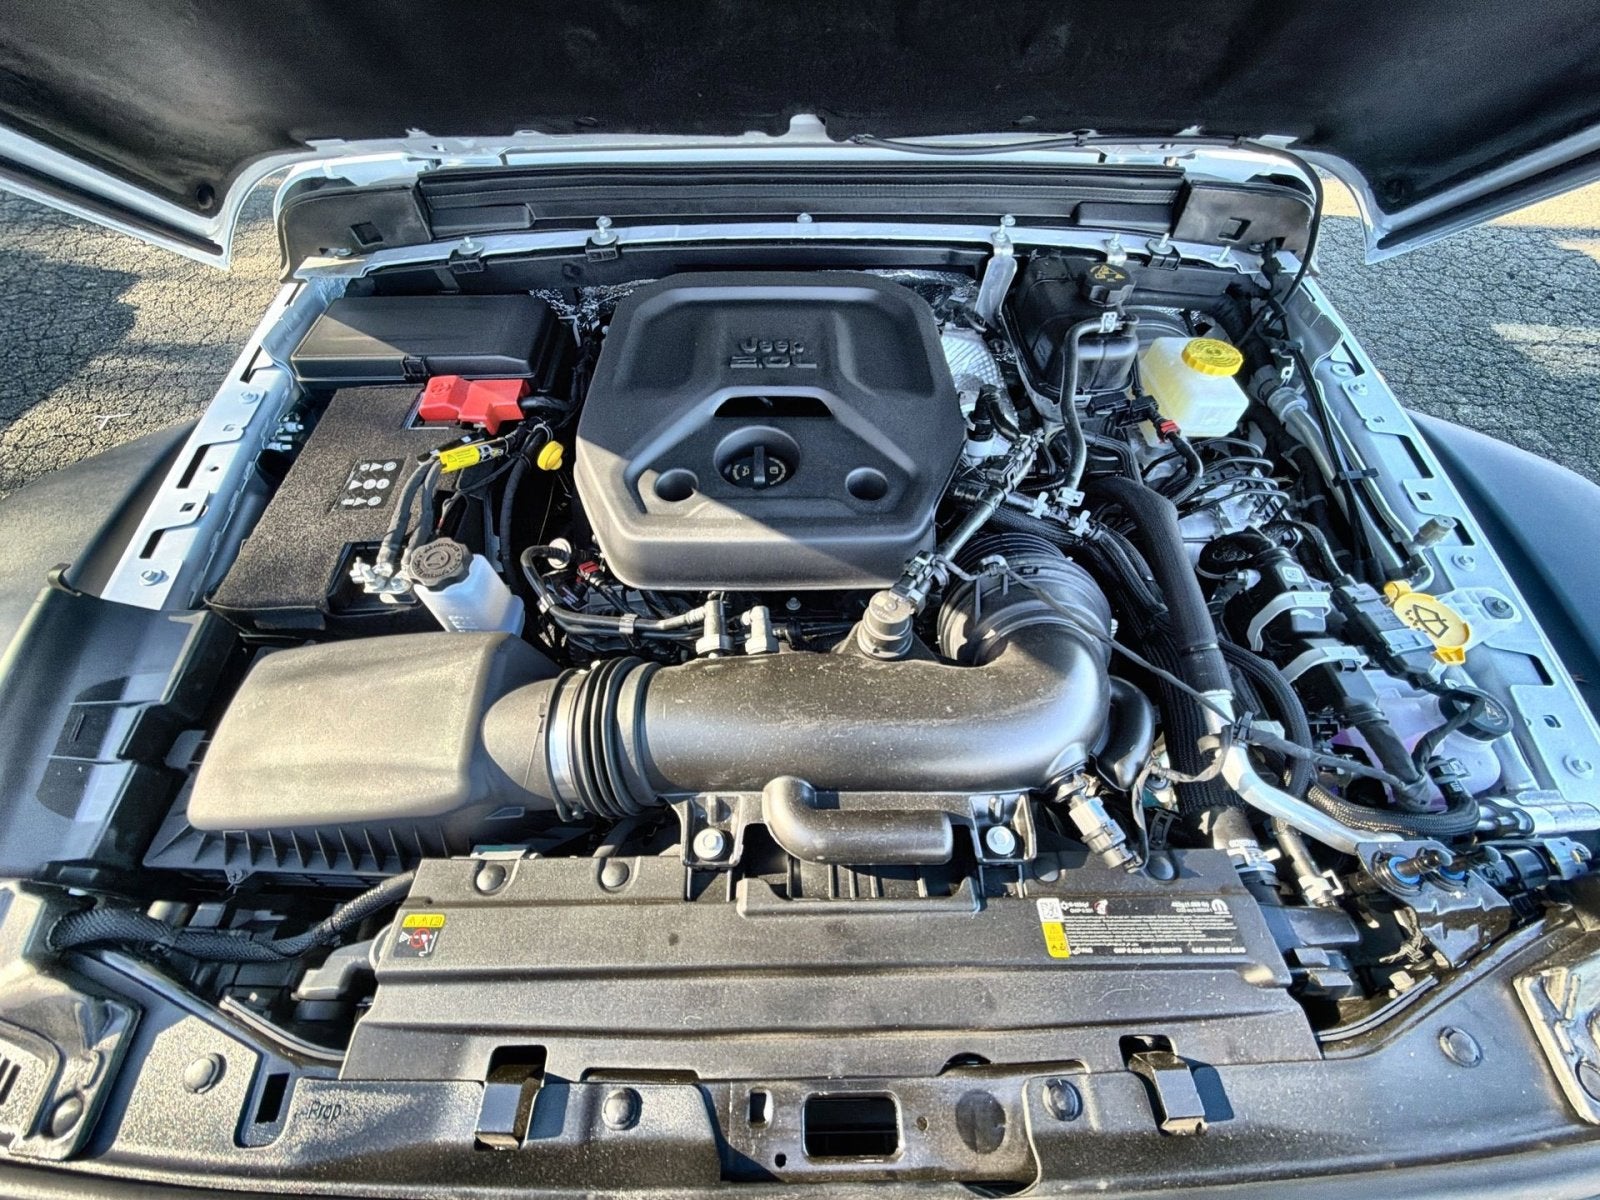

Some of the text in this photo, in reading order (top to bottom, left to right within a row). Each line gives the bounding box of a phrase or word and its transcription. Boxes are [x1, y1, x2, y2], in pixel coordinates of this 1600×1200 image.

[740, 337, 804, 355] Jeep
[730, 355, 817, 369] 2.0L
[307, 1100, 342, 1122] Prop
